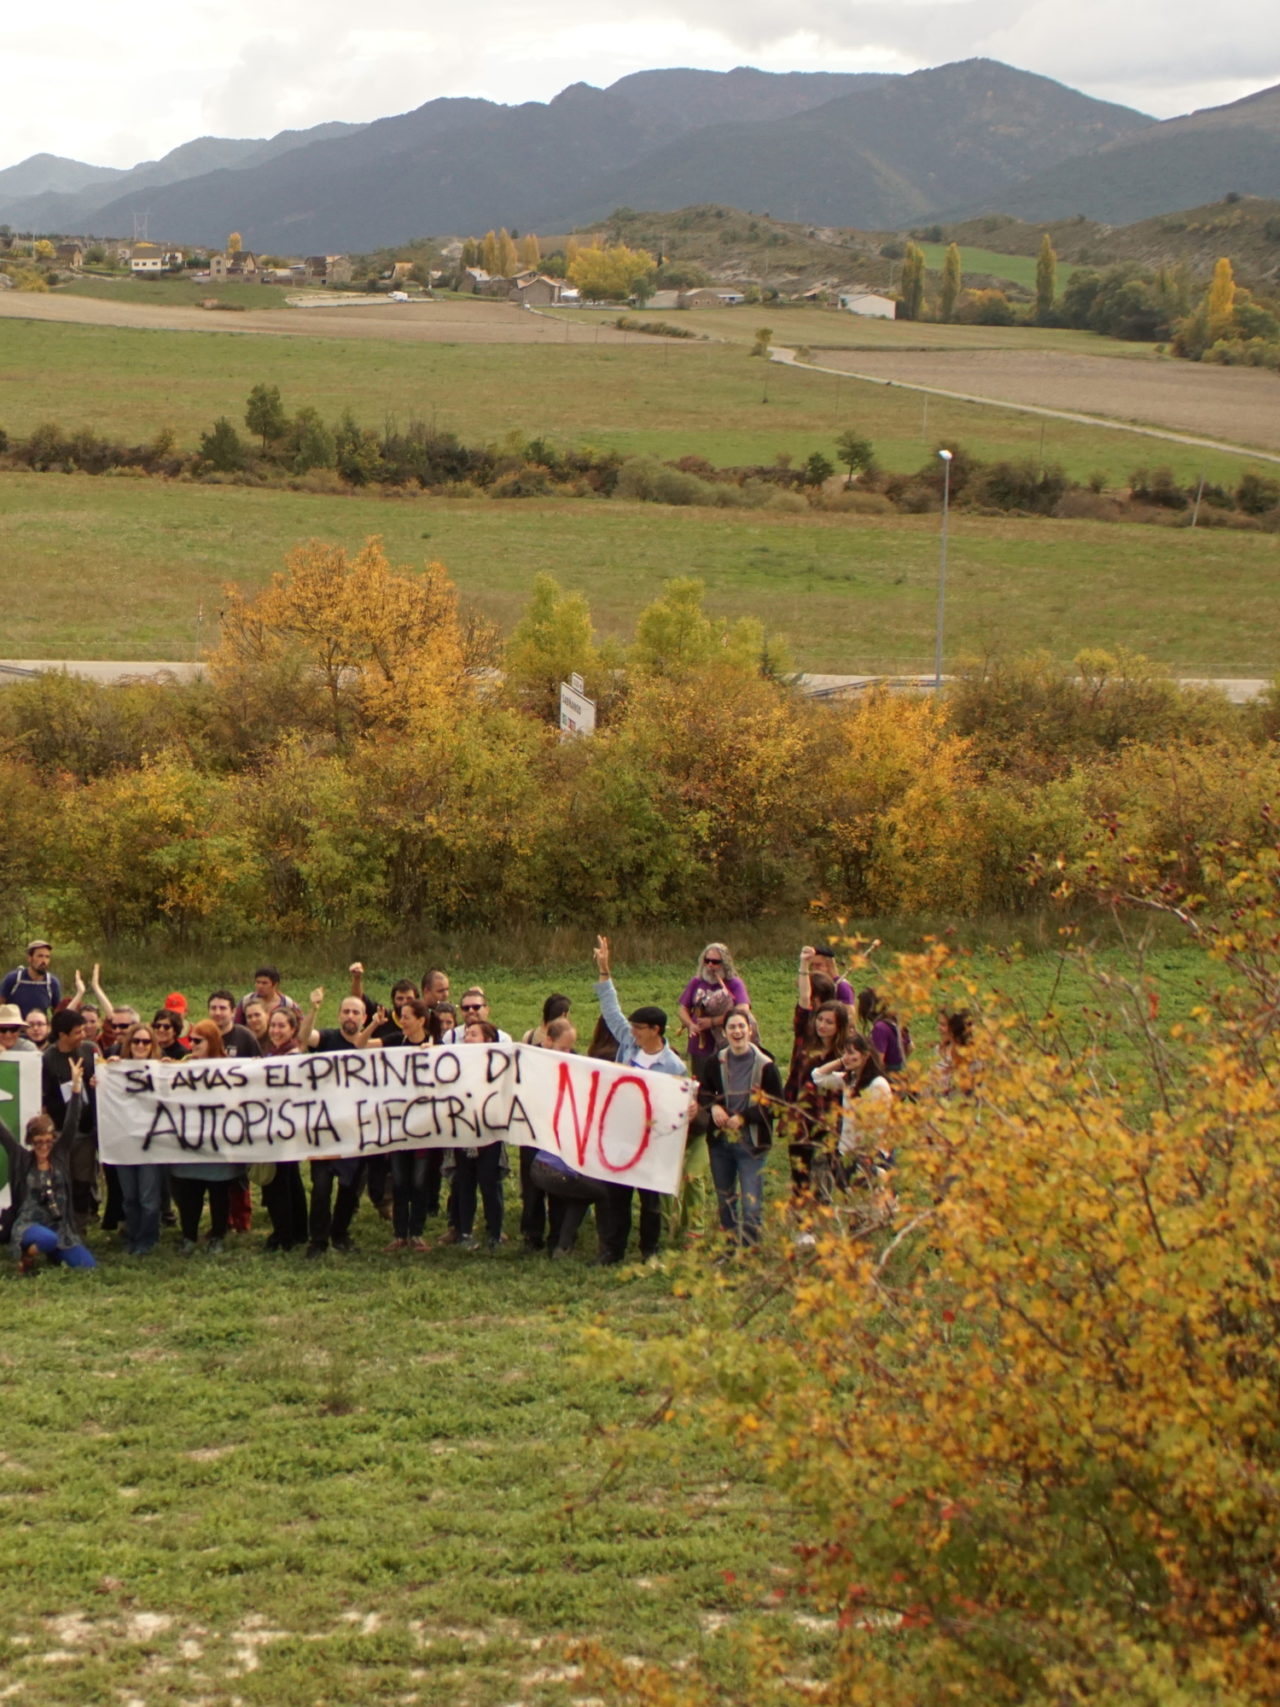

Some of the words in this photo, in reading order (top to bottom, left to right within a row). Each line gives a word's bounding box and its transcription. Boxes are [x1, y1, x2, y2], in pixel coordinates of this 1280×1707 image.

[171, 1065, 248, 1091] AMAS
[264, 1064, 302, 1088] EL
[299, 1051, 462, 1090] PIRINEO
[486, 1049, 521, 1084] DI
[552, 1062, 653, 1173] NO
